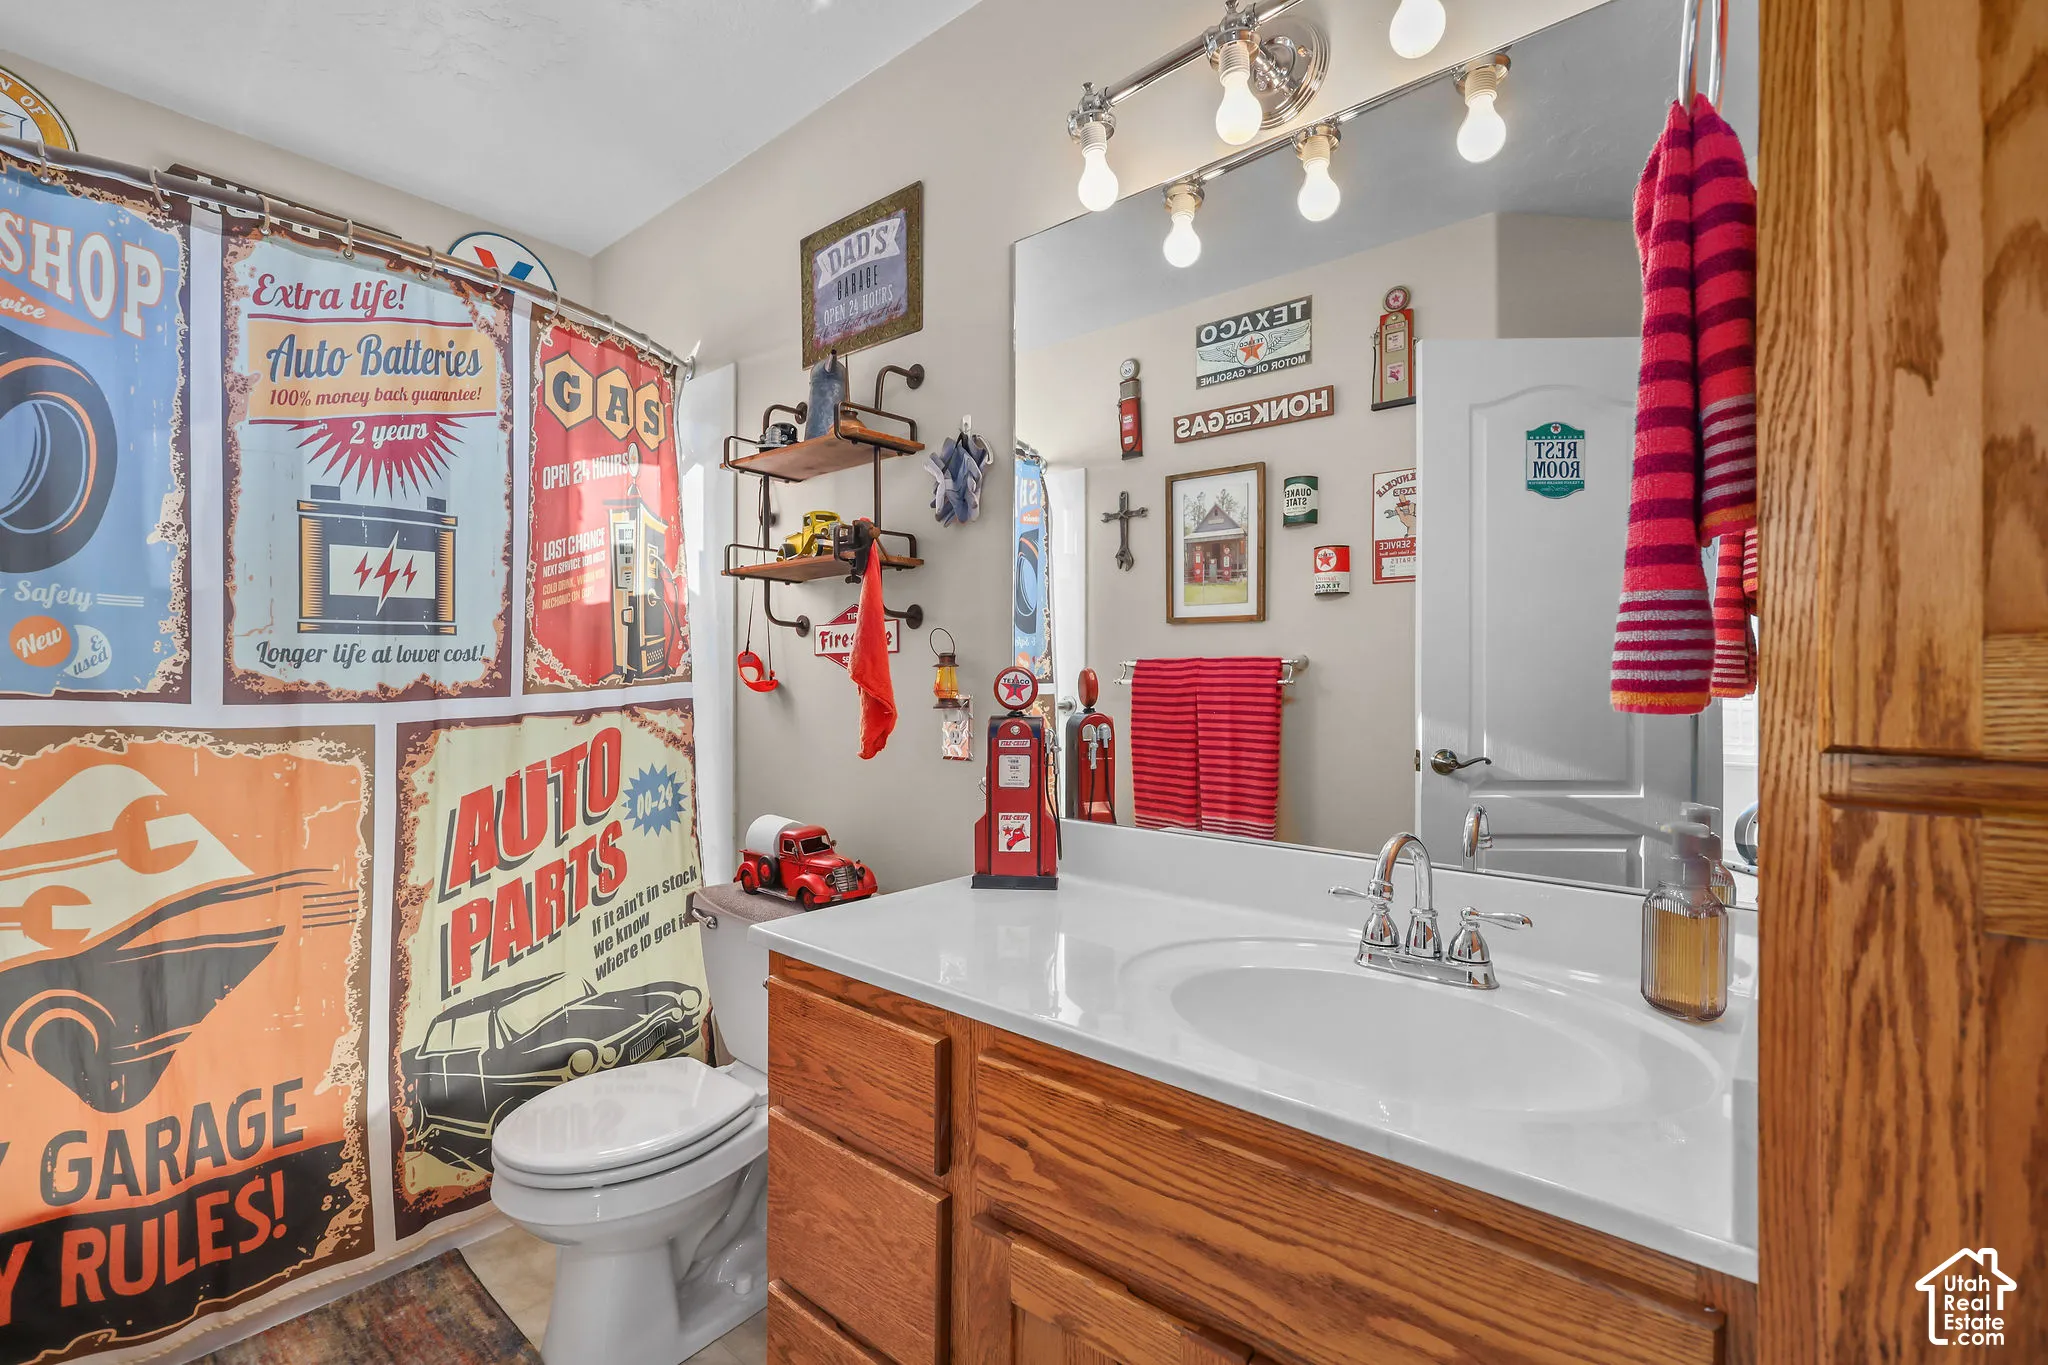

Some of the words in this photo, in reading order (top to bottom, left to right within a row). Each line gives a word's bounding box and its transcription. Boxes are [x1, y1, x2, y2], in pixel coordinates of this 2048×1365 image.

[20, 95, 46, 115] OF
[828, 225, 889, 276] DAD'S
[0, 209, 164, 340] SHOP
[837, 265, 878, 301] GARAGE
[252, 273, 343, 310] Extra
[350, 280, 408, 320] life!
[824, 303, 846, 326] OPEN
[849, 299, 859, 317] 24
[862, 284, 893, 312] HOURS
[266, 333, 352, 383] Auto
[357, 333, 482, 378] Batteries
[270, 389, 311, 406] 100%
[315, 389, 370, 408] money
[374, 387, 408, 401] back
[412, 386, 482, 405] guarantee!
[552, 371, 661, 437] GAS
[350, 420, 365, 444] 2
[371, 421, 429, 450] years
[542, 463, 570, 490] OPEN
[573, 460, 590, 484] 24
[592, 452, 629, 480] HOURS
[543, 537, 566, 561] LAST
[568, 527, 605, 555] CHANCE
[543, 563, 558, 578] NEXT
[14, 579, 93, 612] Safety
[16, 627, 63, 659] New
[73, 647, 108, 675] used
[90, 635, 104, 652] &
[256, 641, 328, 668] Longer
[332, 643, 366, 669] life
[371, 648, 392, 663] at
[396, 645, 440, 663] lower
[443, 645, 486, 664] cost!
[819, 630, 892, 652] Firee
[442, 727, 622, 898] AUTO
[636, 780, 674, 821] 00-24
[445, 820, 628, 995] PARTS
[592, 915, 601, 937] If
[604, 910, 615, 930] it
[616, 891, 644, 921] ain't
[646, 884, 660, 903] in
[661, 865, 698, 894] stock
[593, 935, 614, 959] we
[616, 911, 650, 946] know
[595, 943, 638, 981] where
[639, 932, 652, 952] to
[654, 916, 677, 944] get
[40, 1078, 304, 1207] GARAGE
[60, 1170, 287, 1308] RULES!
